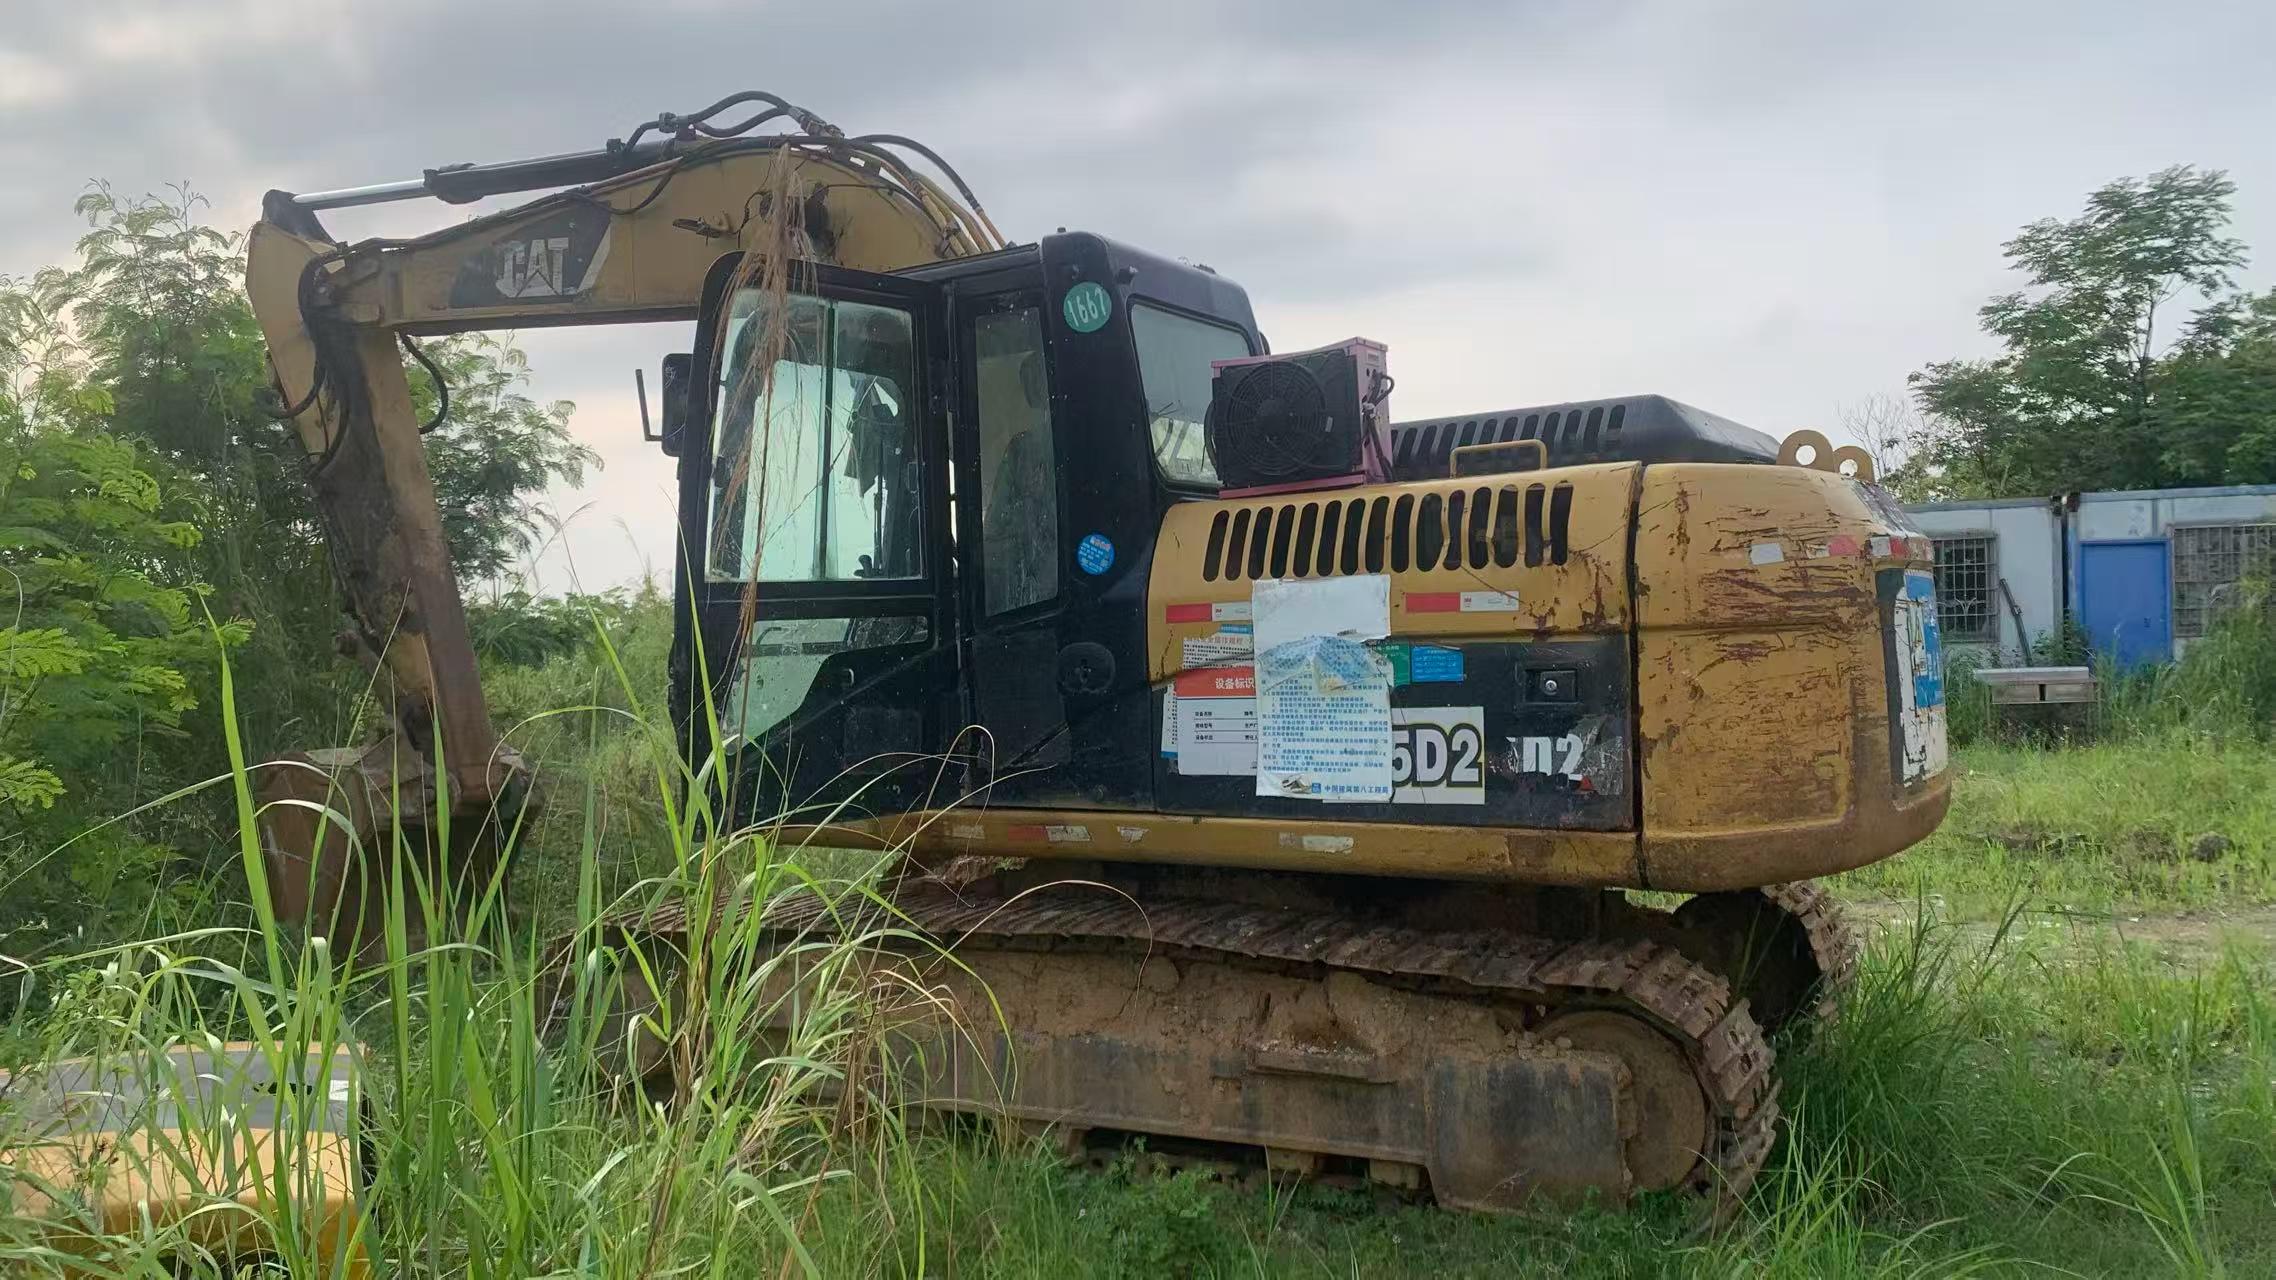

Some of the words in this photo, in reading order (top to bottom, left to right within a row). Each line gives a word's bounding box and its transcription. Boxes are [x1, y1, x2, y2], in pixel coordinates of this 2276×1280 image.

[499, 238, 569, 298] CAT
[1067, 286, 1107, 328] 1667
[1215, 677, 1256, 690] 设备标识
